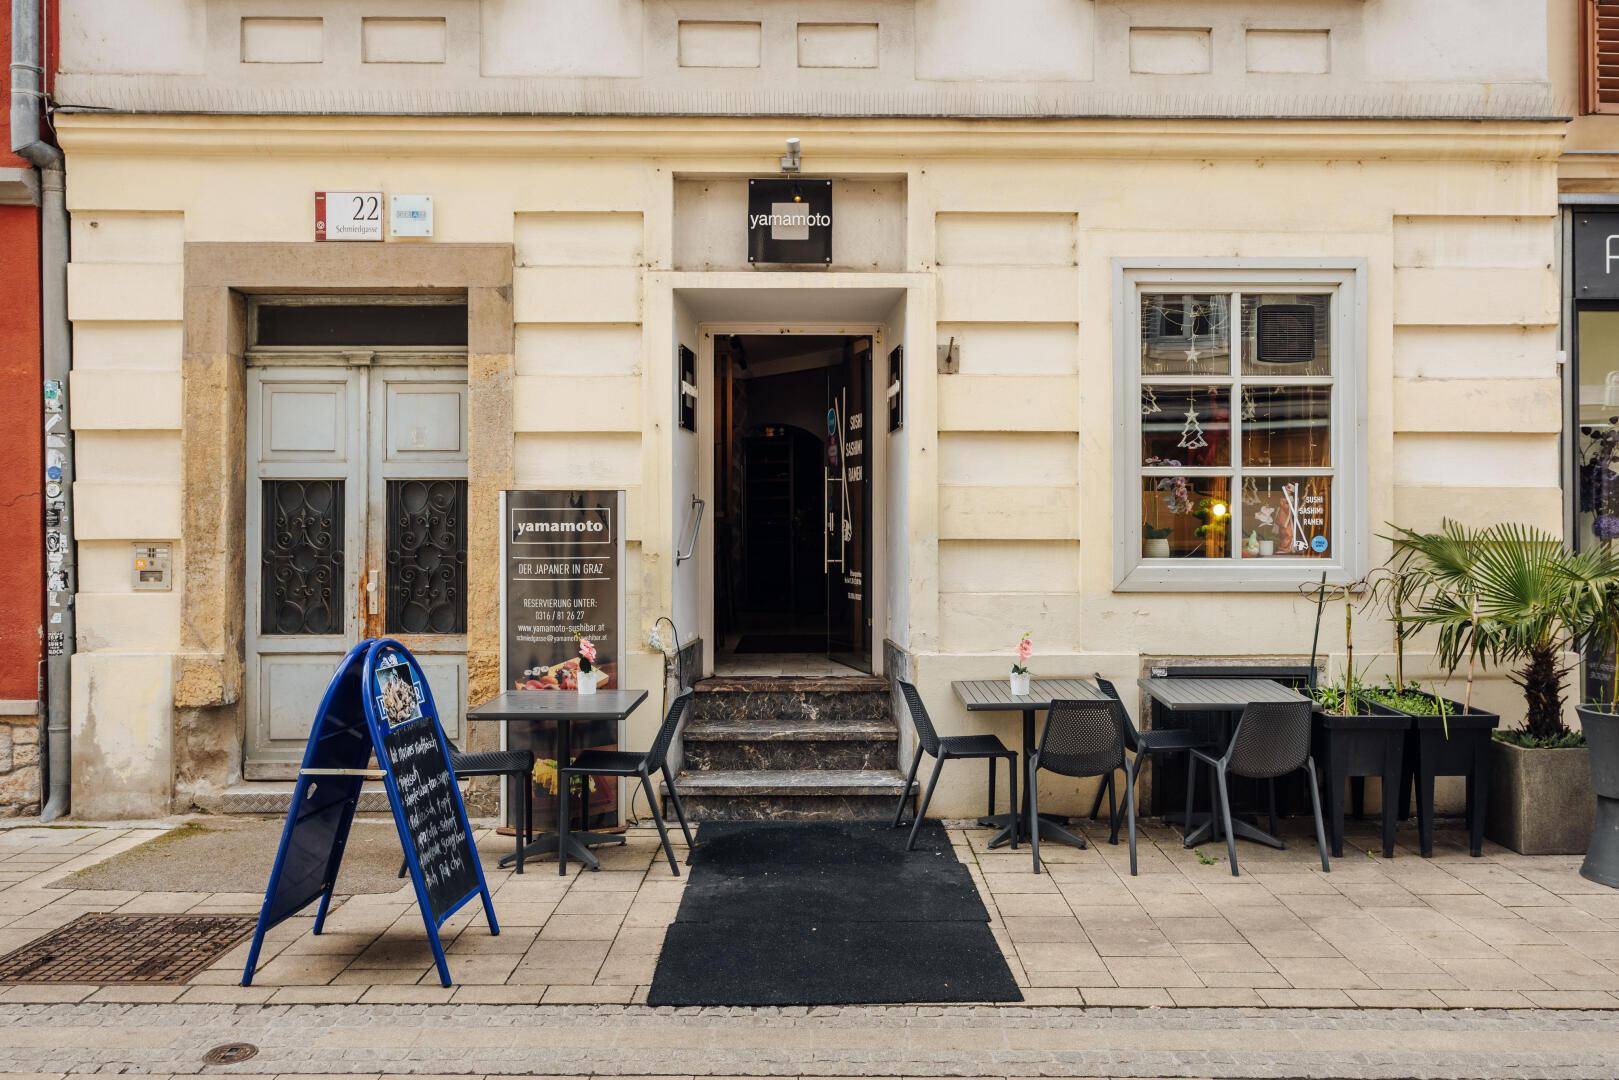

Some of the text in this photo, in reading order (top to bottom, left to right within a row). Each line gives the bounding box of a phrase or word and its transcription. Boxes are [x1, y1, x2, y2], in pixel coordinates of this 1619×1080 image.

[352, 196, 379, 221] 22
[750, 212, 831, 230] yamamoto
[335, 225, 378, 235] Schmiedgasse
[849, 413, 863, 431] SUSHI
[845, 440, 863, 457] SASHIMI
[848, 465, 863, 482] RAMEN
[518, 520, 604, 536] yamamoto
[518, 563, 604, 575] DER JAPANER IN GRAZ
[523, 598, 598, 608] RESERVIERUNG UNTER:
[535, 610, 551, 620] 0316
[556, 610, 565, 620] 81
[566, 610, 575, 620] 26
[576, 610, 585, 620] 27
[518, 623, 605, 633] www.yamamoto-sushibar.at
